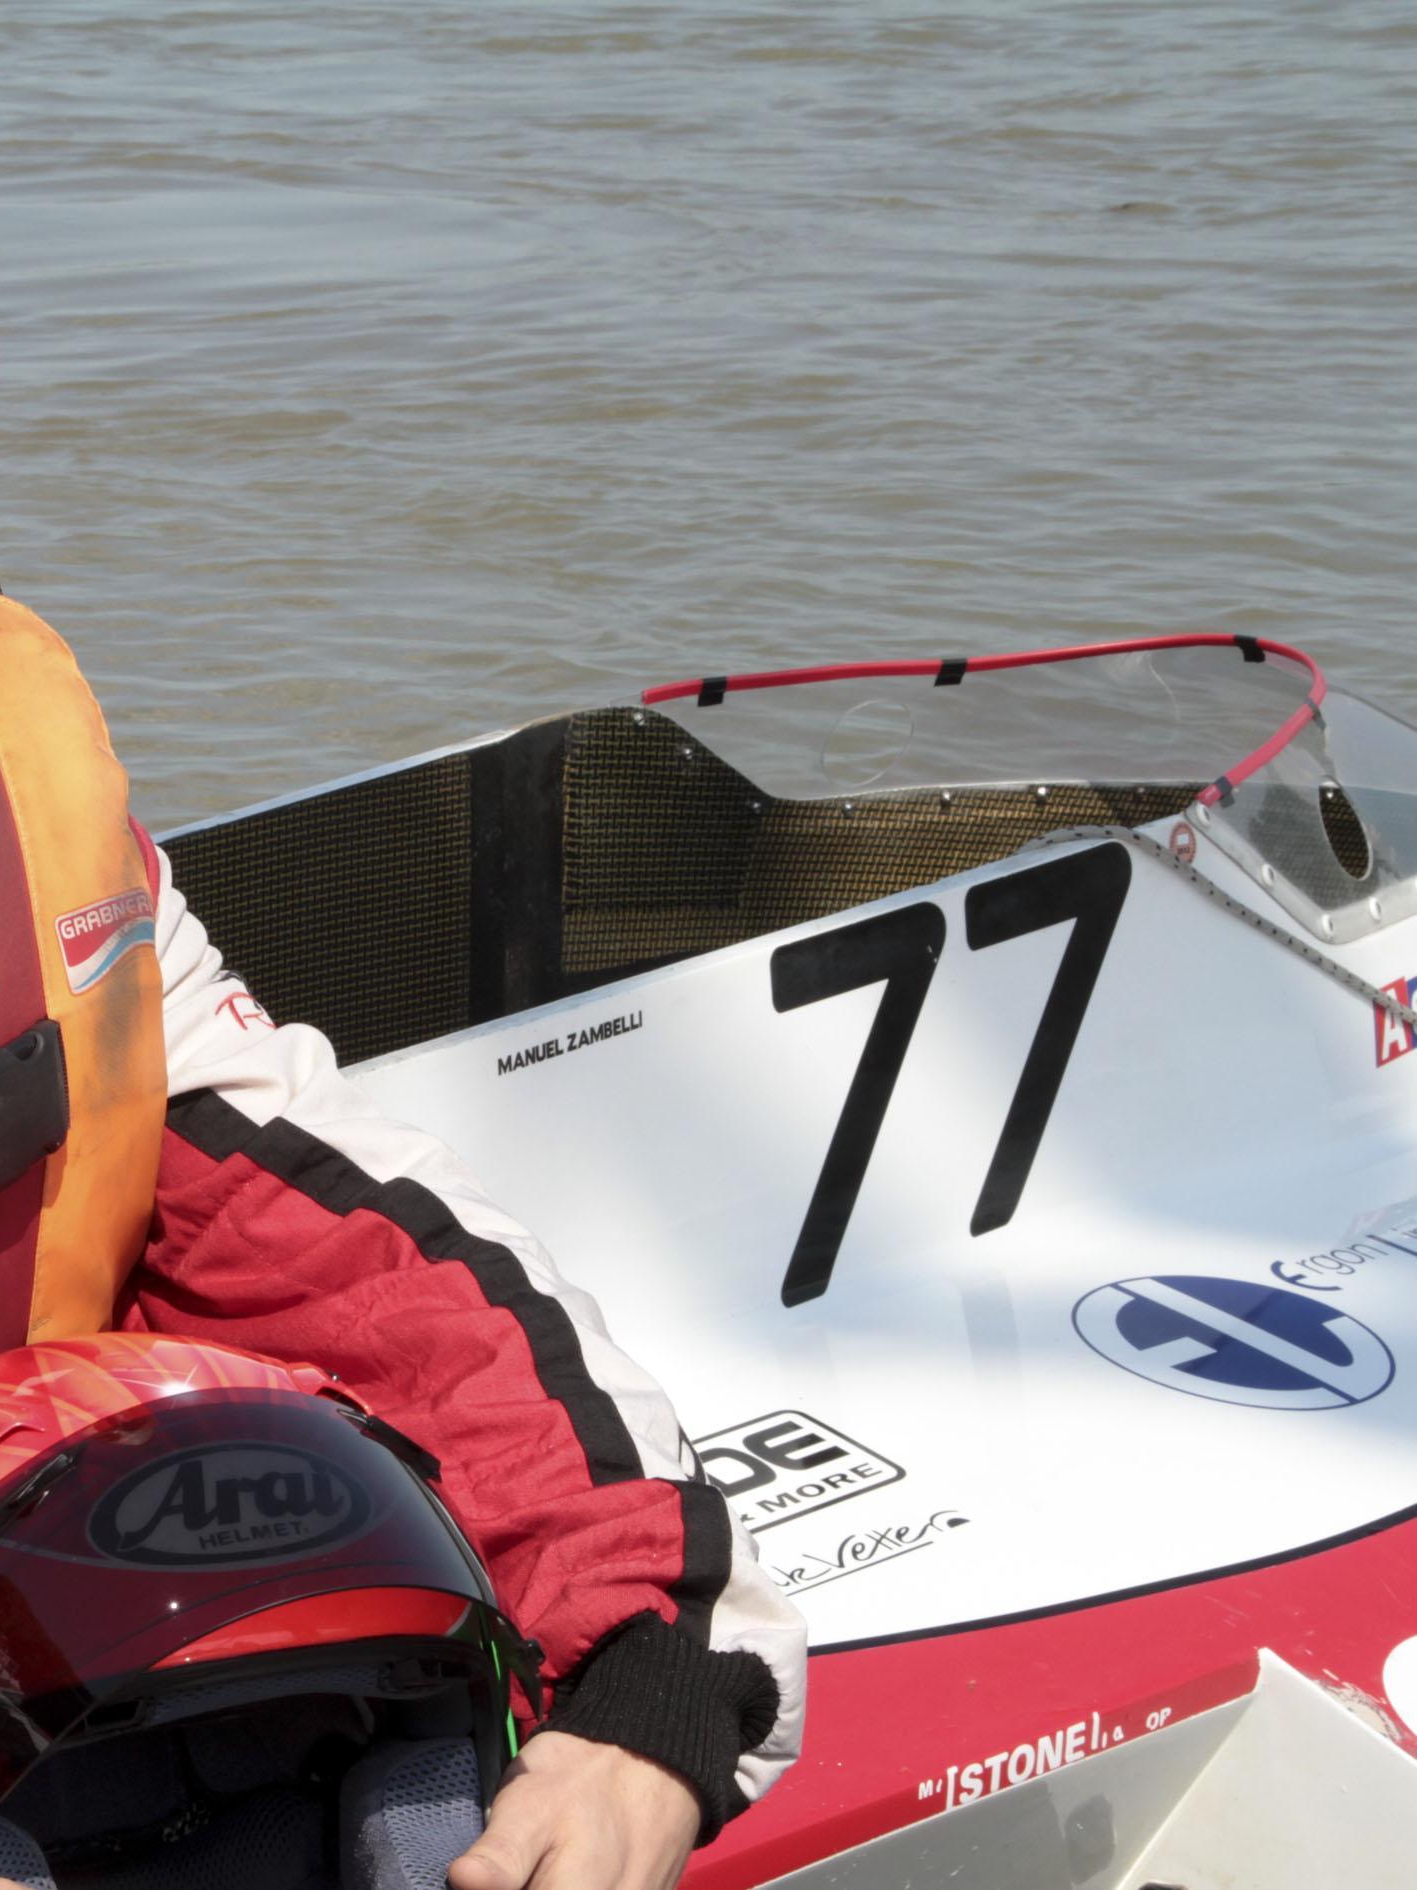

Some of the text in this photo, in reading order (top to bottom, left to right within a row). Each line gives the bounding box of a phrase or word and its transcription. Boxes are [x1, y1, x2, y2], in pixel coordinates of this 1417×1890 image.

[60, 894, 153, 940] GRABNER
[497, 1010, 643, 1076] MANUEL ZAMBELLI
[770, 841, 1132, 1308] 77
[118, 1459, 347, 1551] Arai
[755, 1462, 884, 1514] MORE
[198, 1521, 305, 1550] HELMET
